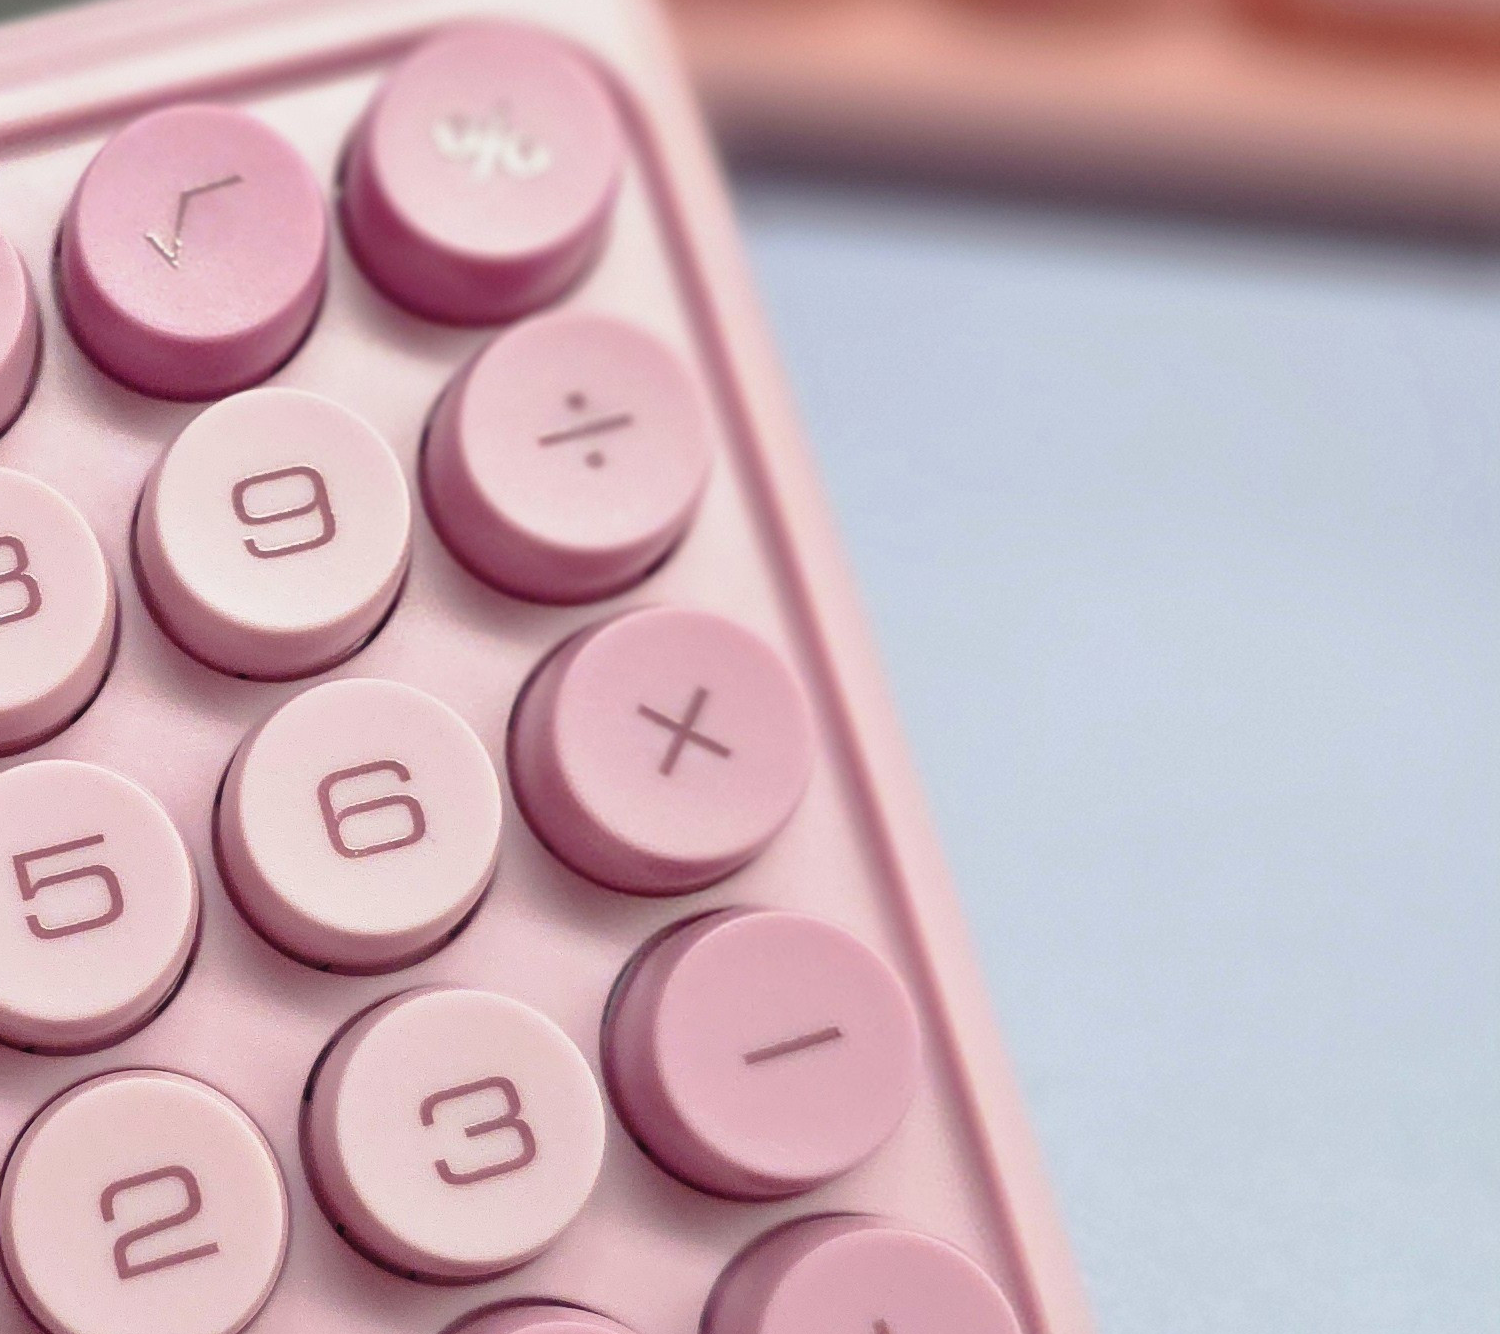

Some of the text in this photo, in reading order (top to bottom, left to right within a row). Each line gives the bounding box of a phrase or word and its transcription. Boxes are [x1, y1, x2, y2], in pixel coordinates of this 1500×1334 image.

[231, 464, 337, 559] 9
[317, 758, 427, 860] 6
[11, 832, 125, 941] 5
[418, 1074, 537, 1187] 3
[100, 1163, 220, 1281] 2
